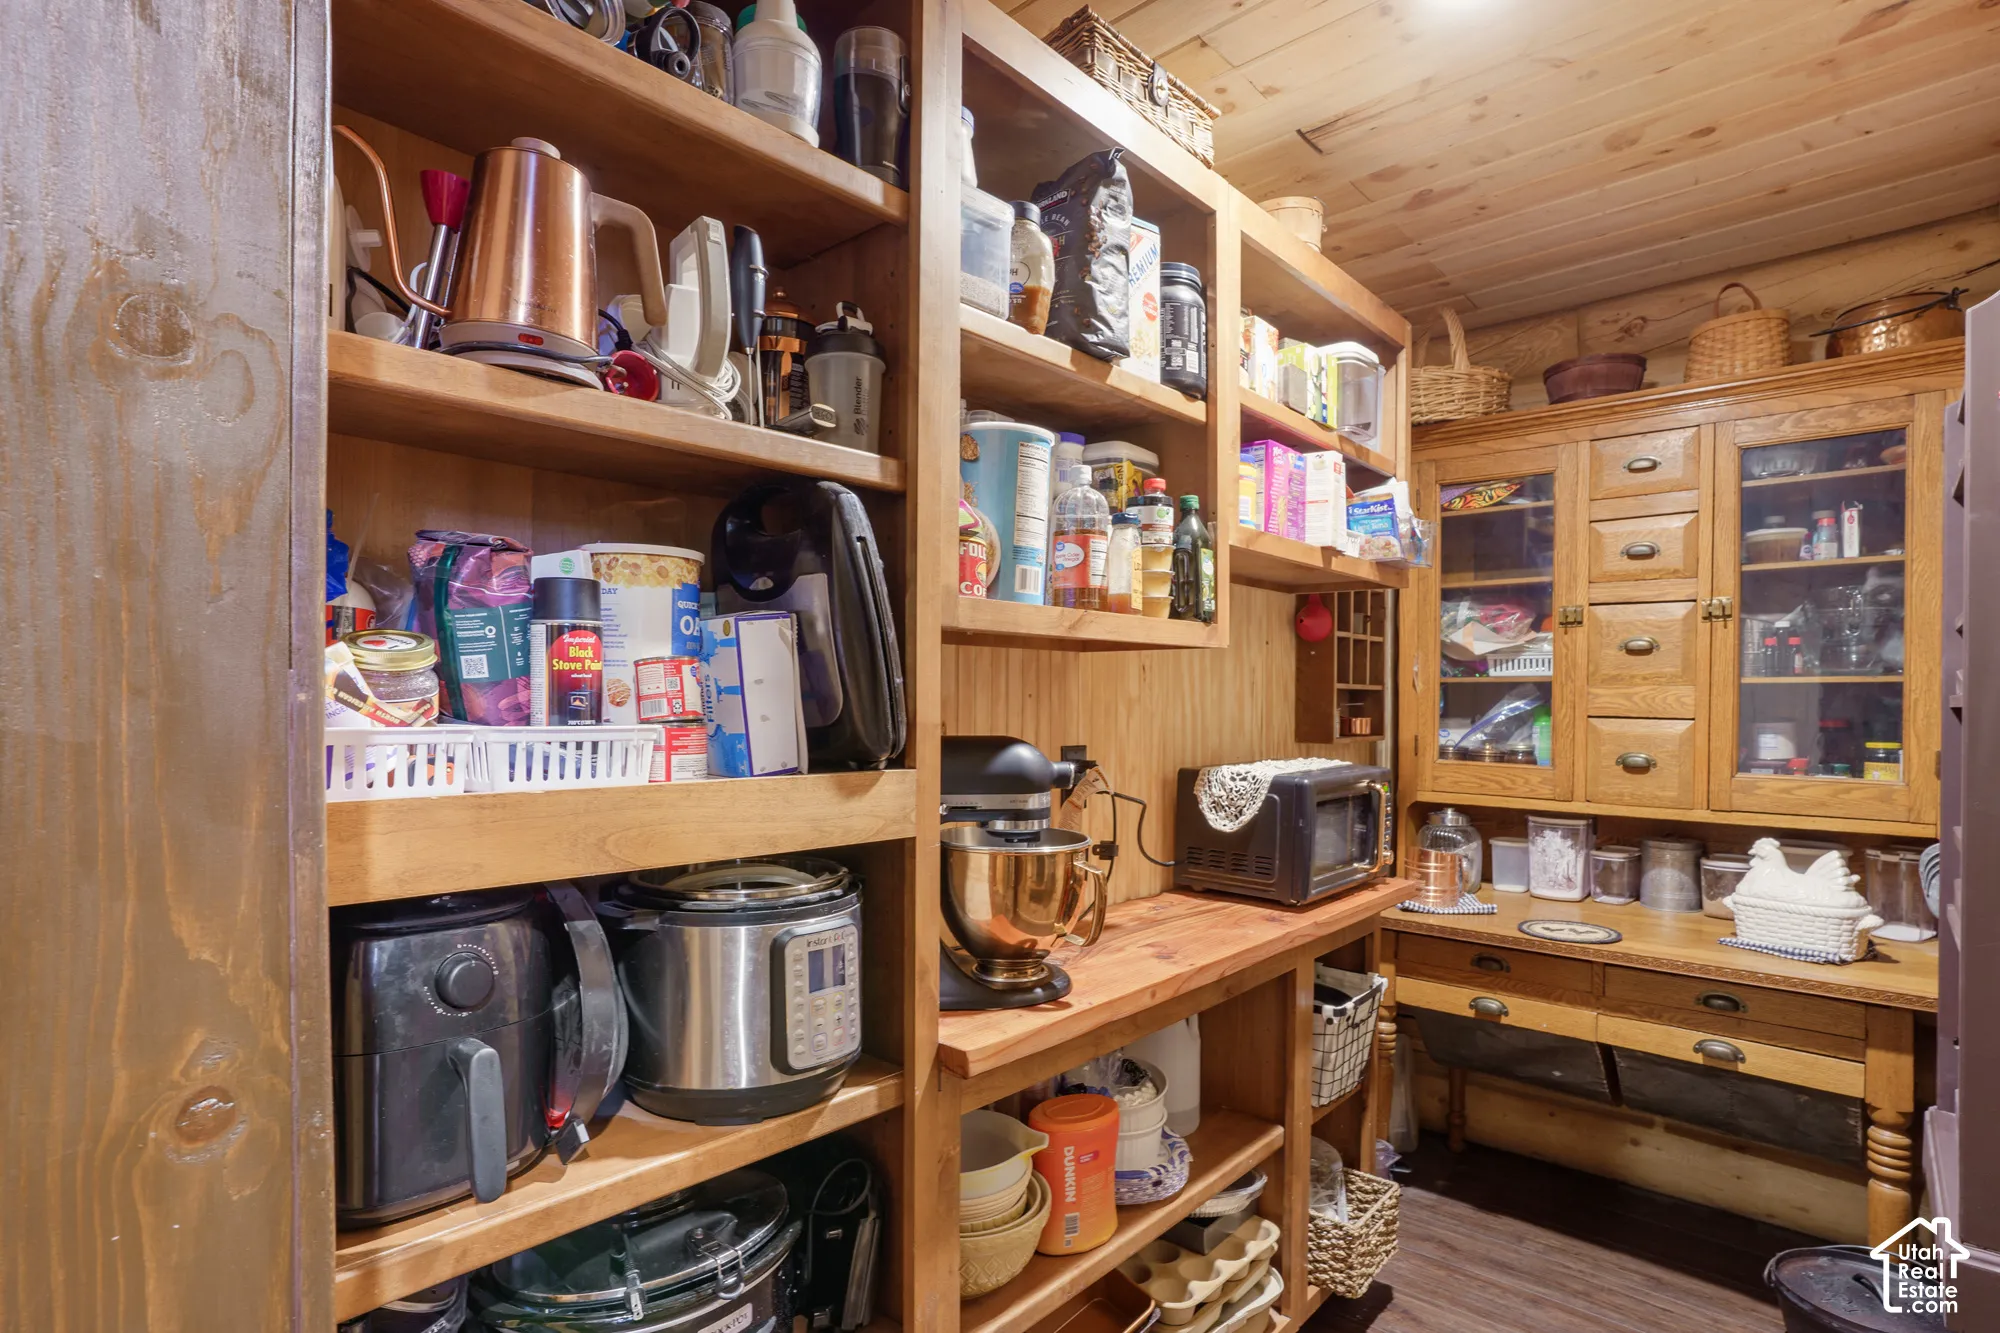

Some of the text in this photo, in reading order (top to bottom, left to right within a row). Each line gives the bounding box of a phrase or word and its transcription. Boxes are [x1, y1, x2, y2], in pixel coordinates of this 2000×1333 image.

[1051, 213, 1071, 227] BEAN
[1128, 243, 1159, 288] REMIUM
[853, 376, 862, 415] Blender
[1353, 503, 1388, 514] StarKist
[680, 615, 700, 636] OA
[562, 634, 596, 645] Imperial
[568, 646, 594, 658] Black
[552, 658, 583, 671] Stove
[375, 710, 401, 725] NORTH
[806, 936, 832, 948] Instant
